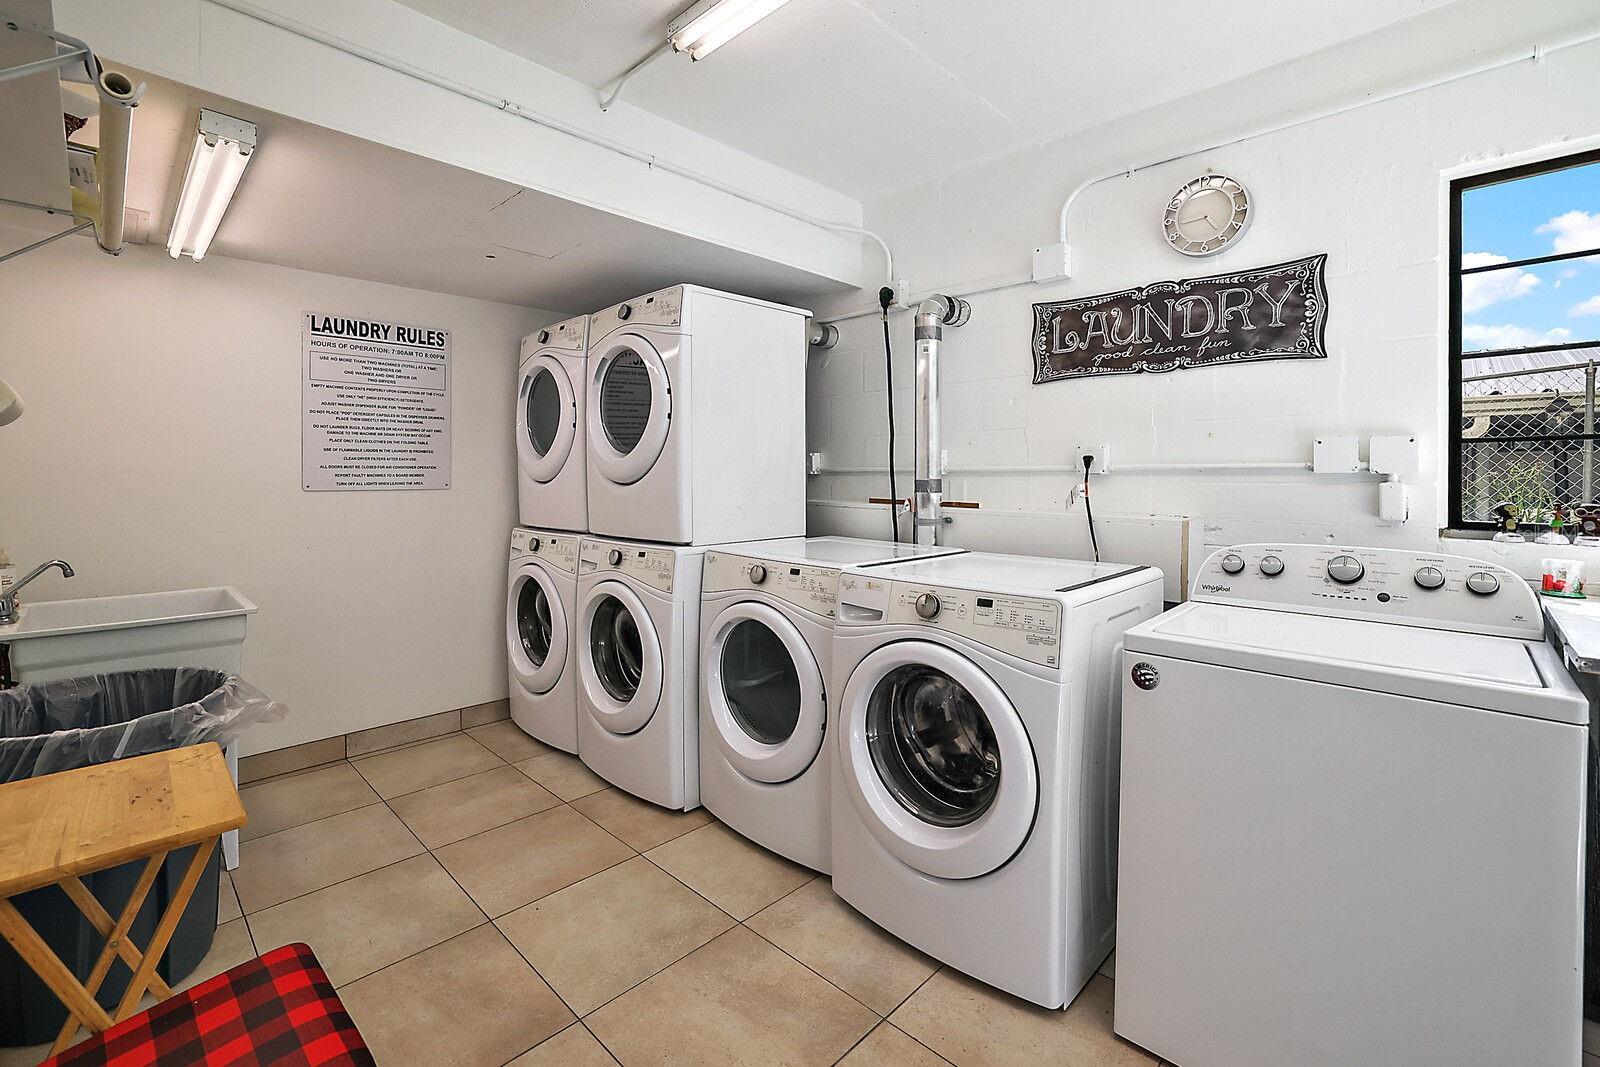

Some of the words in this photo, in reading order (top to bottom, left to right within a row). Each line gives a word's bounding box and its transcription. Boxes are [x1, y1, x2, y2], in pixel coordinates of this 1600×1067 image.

[311, 315, 391, 340] LAUNDRY
[396, 326, 445, 347] RULES
[1051, 280, 1300, 354] LAUNDRY
[311, 340, 336, 348] HOURS
[1092, 344, 1134, 365] good
[1138, 342, 1189, 356] clean
[1196, 337, 1232, 357] fun
[1202, 584, 1231, 593] Whirlpool
